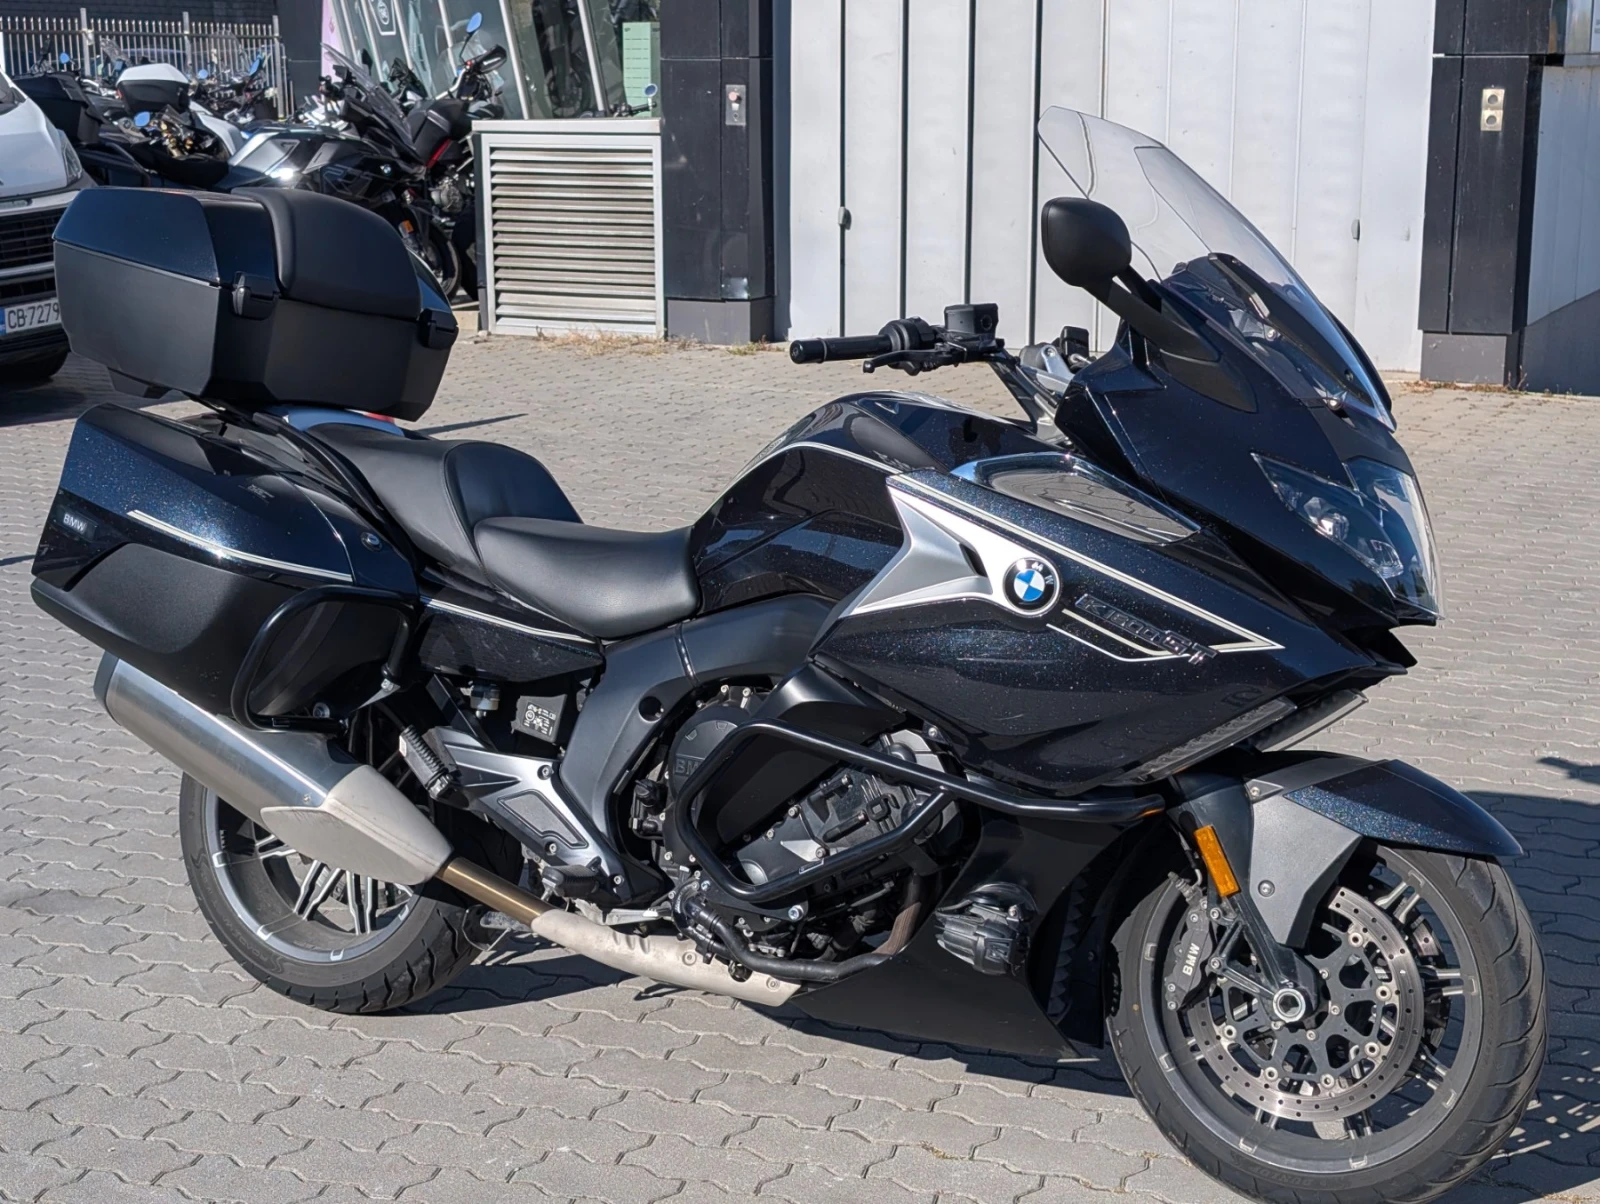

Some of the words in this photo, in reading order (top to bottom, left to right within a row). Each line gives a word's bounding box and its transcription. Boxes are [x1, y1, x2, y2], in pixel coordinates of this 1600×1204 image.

[63, 512, 88, 535] BMW
[675, 758, 705, 775] BM
[1182, 942, 1200, 976] BMW
